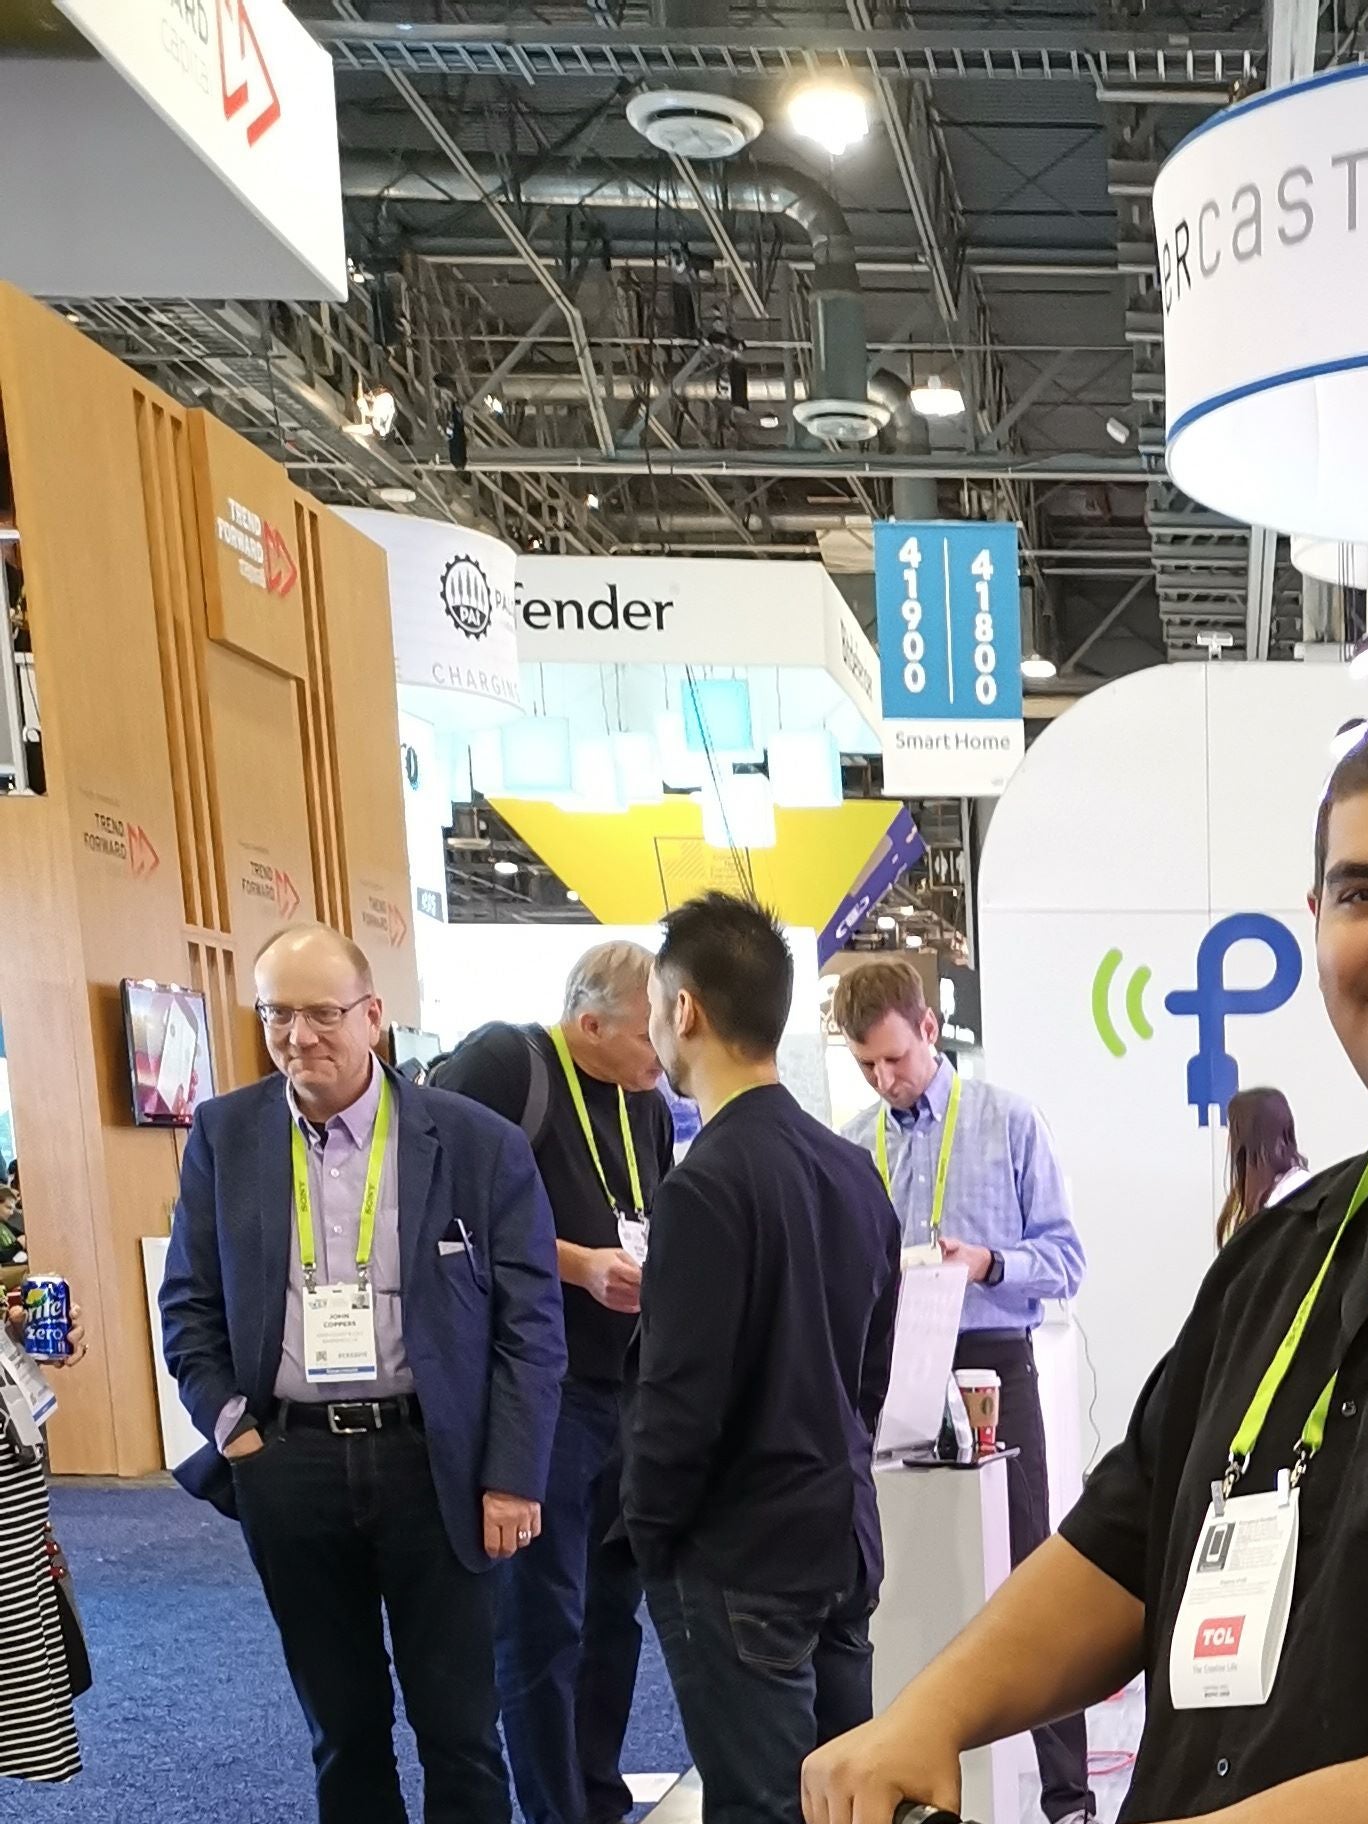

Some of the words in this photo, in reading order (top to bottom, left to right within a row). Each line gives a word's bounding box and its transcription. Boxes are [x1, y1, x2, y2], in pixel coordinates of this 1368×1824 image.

[898, 536, 927, 694] 41900
[970, 548, 998, 706] 41800
[895, 731, 951, 750] Smart
[954, 731, 1011, 750] Home
[25, 1325, 63, 1341] zero
[1203, 1626, 1235, 1647] TCL
